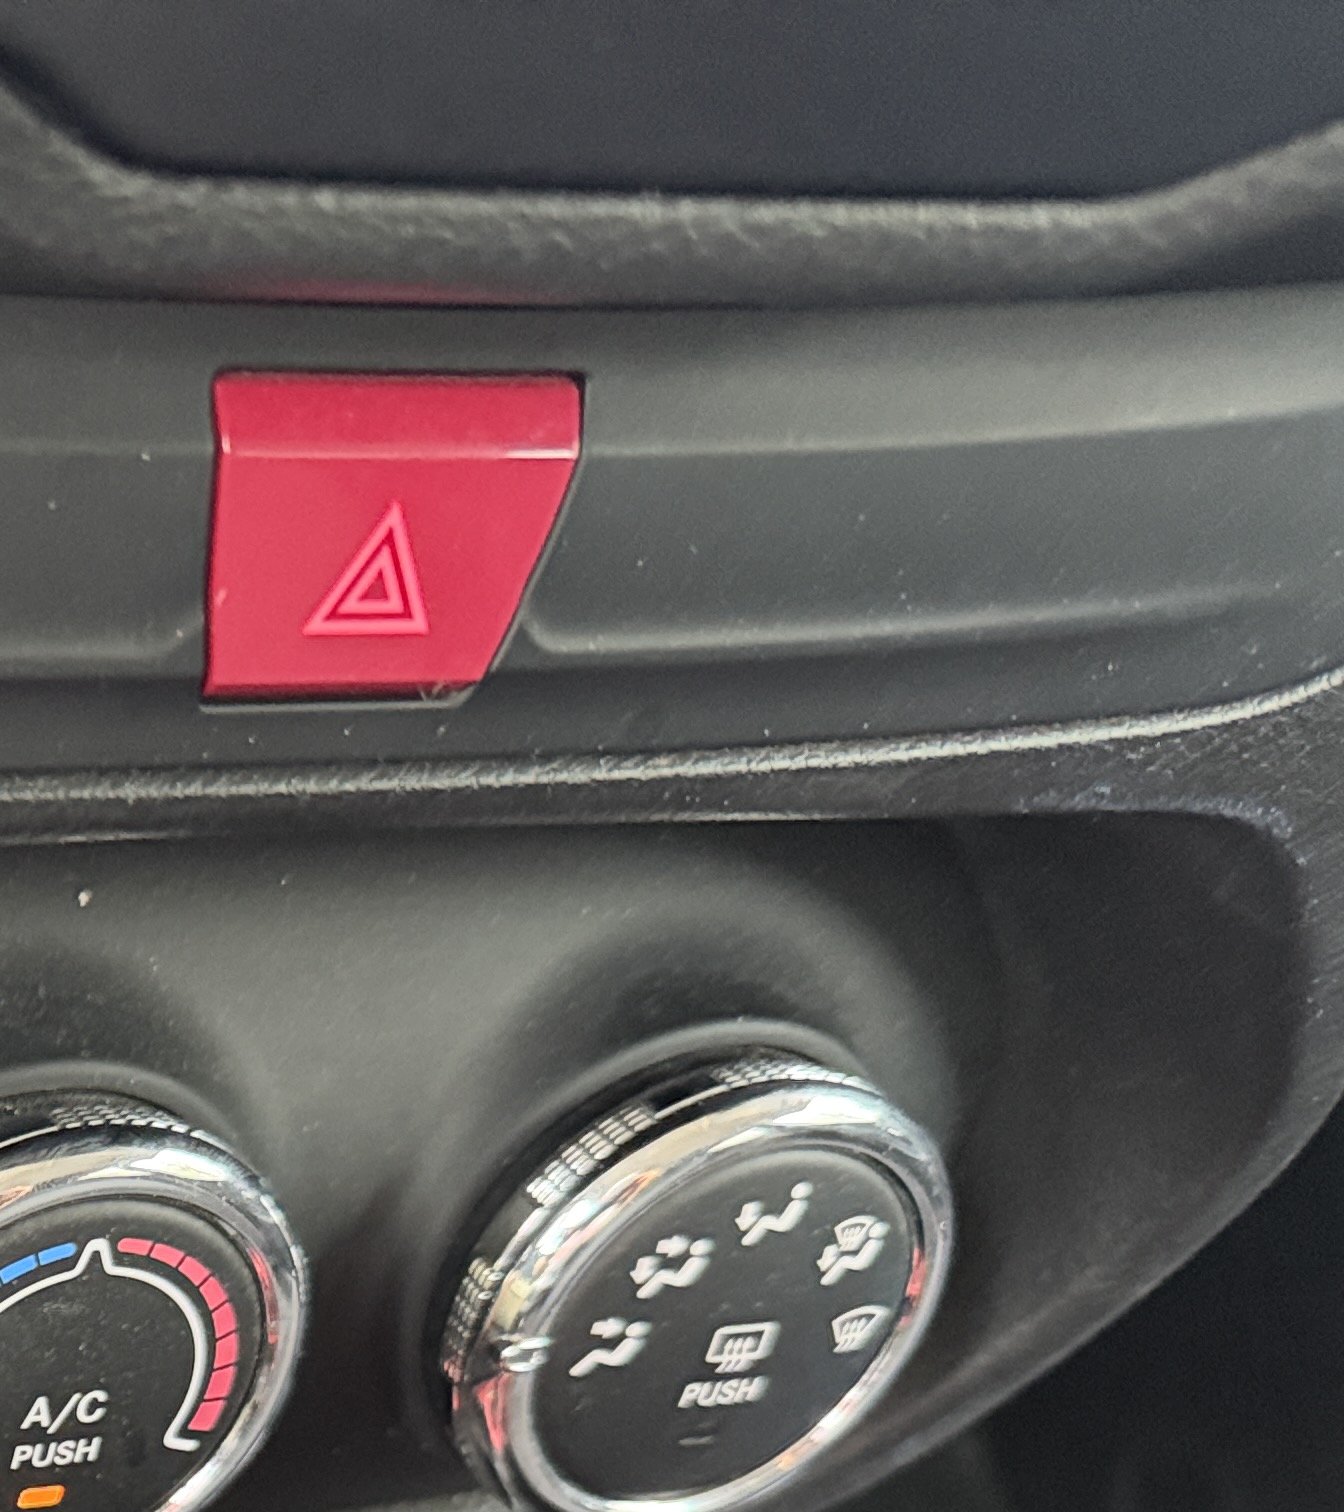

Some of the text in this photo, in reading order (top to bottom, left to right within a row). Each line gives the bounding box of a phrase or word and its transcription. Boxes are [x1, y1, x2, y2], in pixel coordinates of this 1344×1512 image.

[678, 1376, 770, 1408] PUSH
[19, 1389, 109, 1435] A/C
[10, 1436, 103, 1470] PUSH
